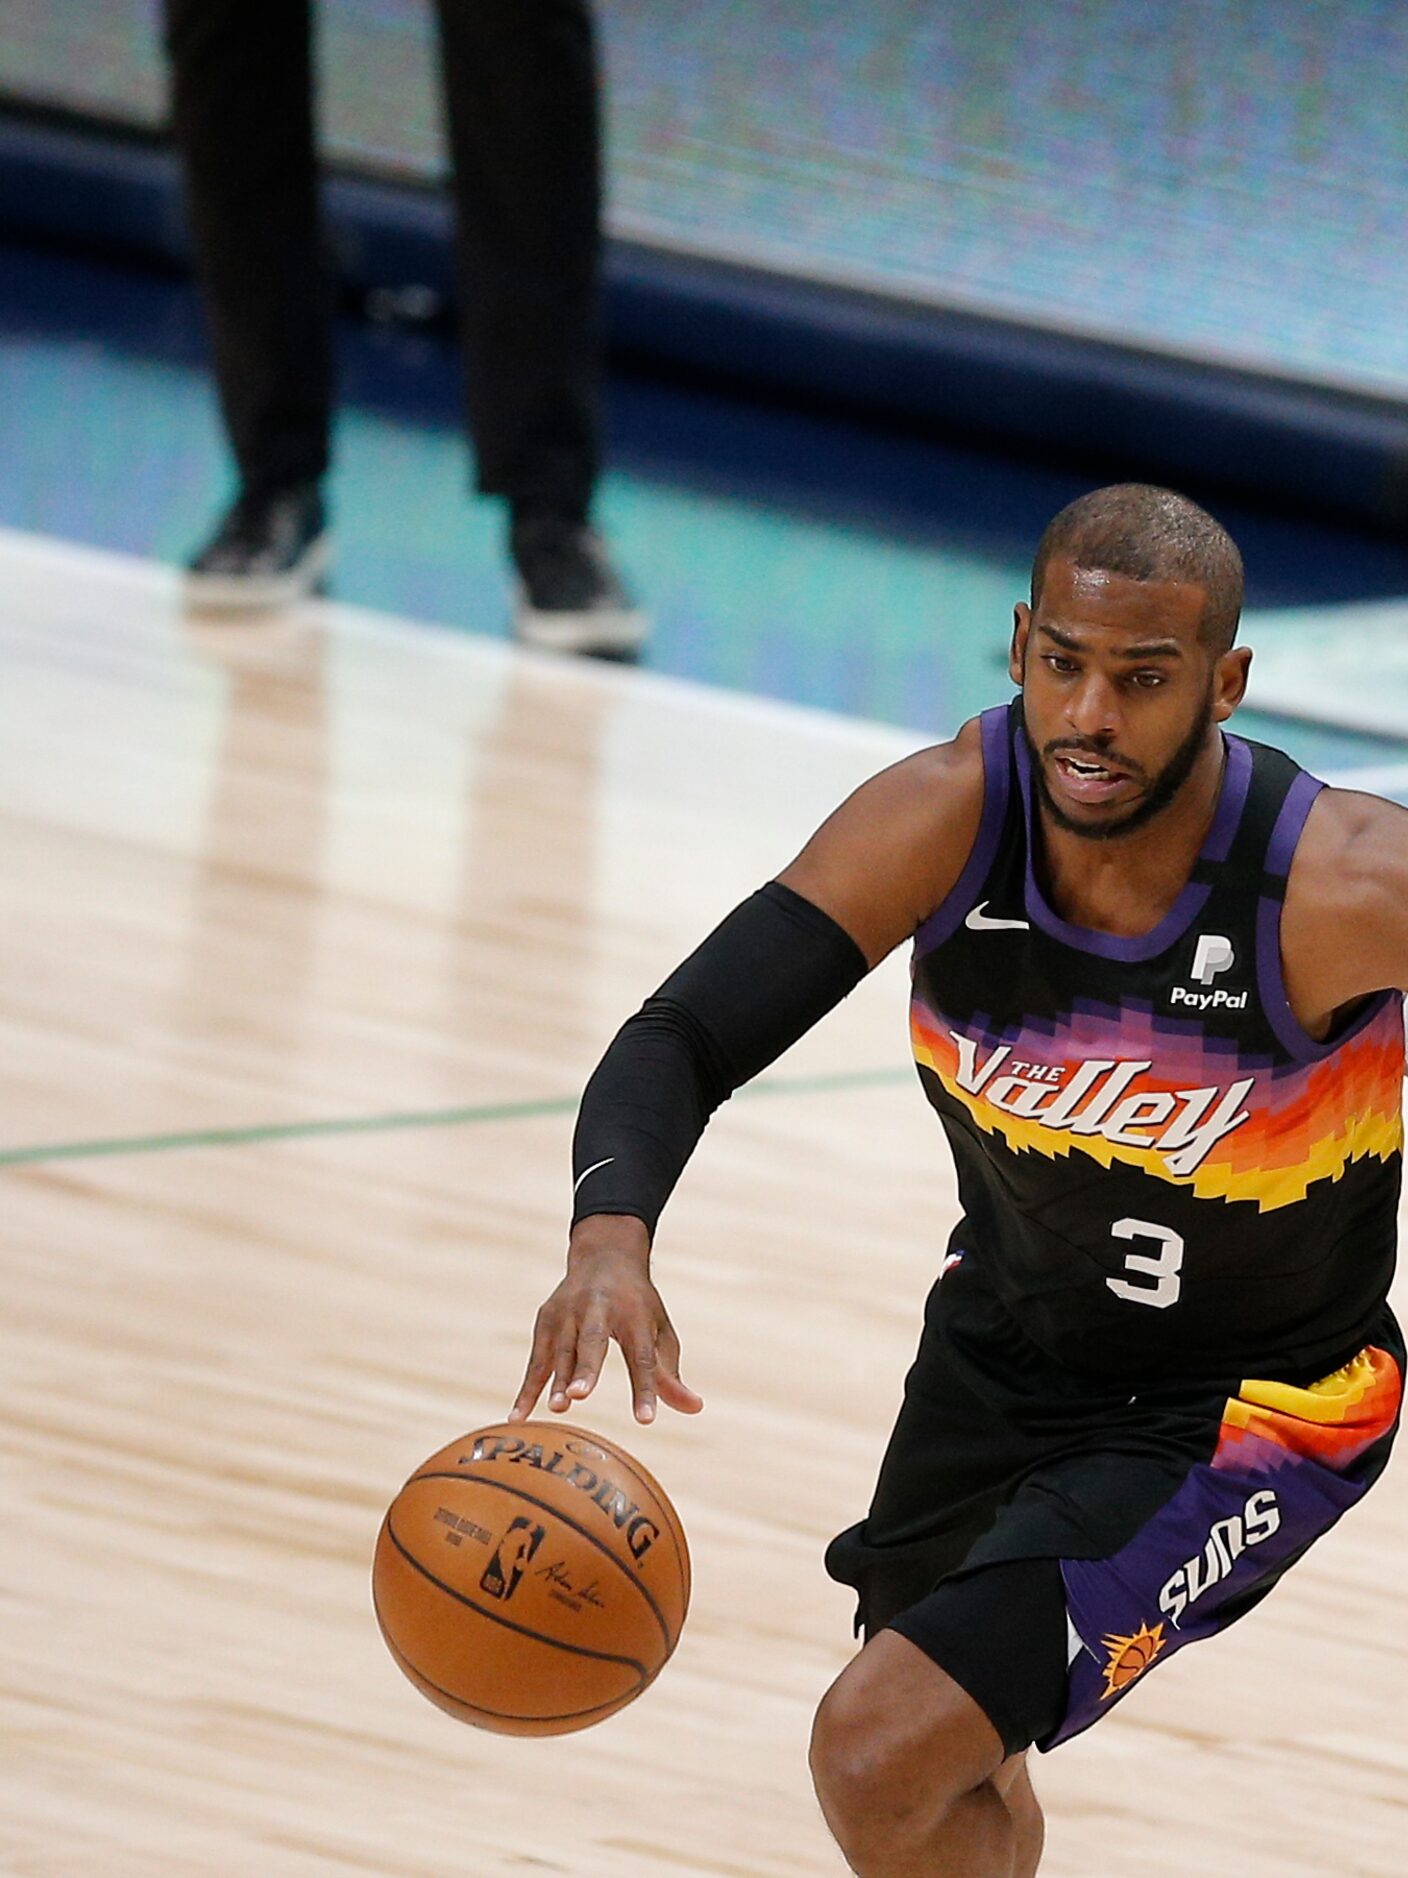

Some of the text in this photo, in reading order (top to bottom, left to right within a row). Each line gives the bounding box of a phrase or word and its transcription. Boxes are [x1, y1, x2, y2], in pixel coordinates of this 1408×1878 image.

[1170, 986, 1248, 1010] PayPal
[949, 1030, 1255, 1176] Valley
[1010, 1061, 1066, 1082] THE
[1106, 1218, 1184, 1309] 3
[458, 1436, 661, 1560] SPALDING
